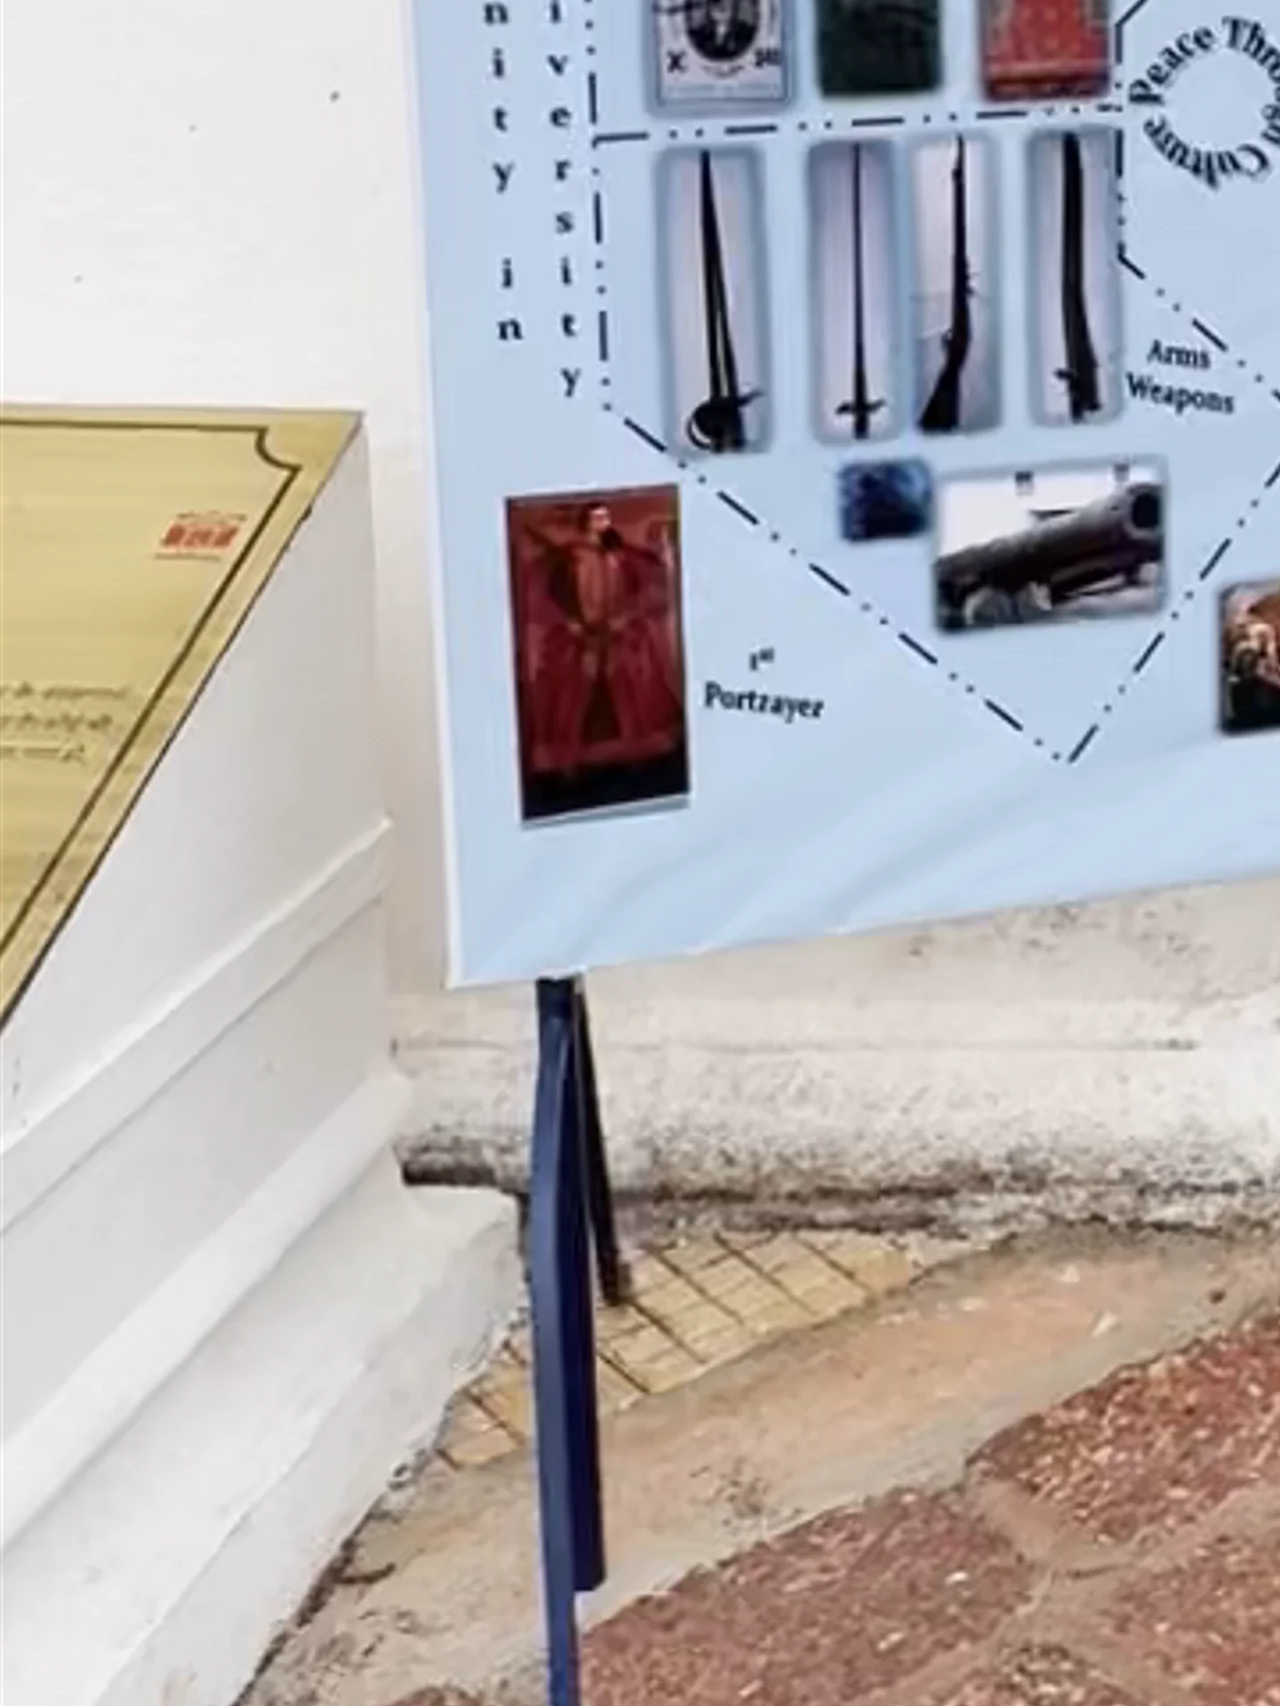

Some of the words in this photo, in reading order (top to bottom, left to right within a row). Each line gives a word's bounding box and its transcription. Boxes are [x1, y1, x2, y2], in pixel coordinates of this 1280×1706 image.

[1129, 27, 1215, 105] Peace
[1144, 115, 1271, 190] Culture
[497, 258, 523, 341] in
[1146, 339, 1211, 369] Arms
[1126, 371, 1234, 415] Weapons
